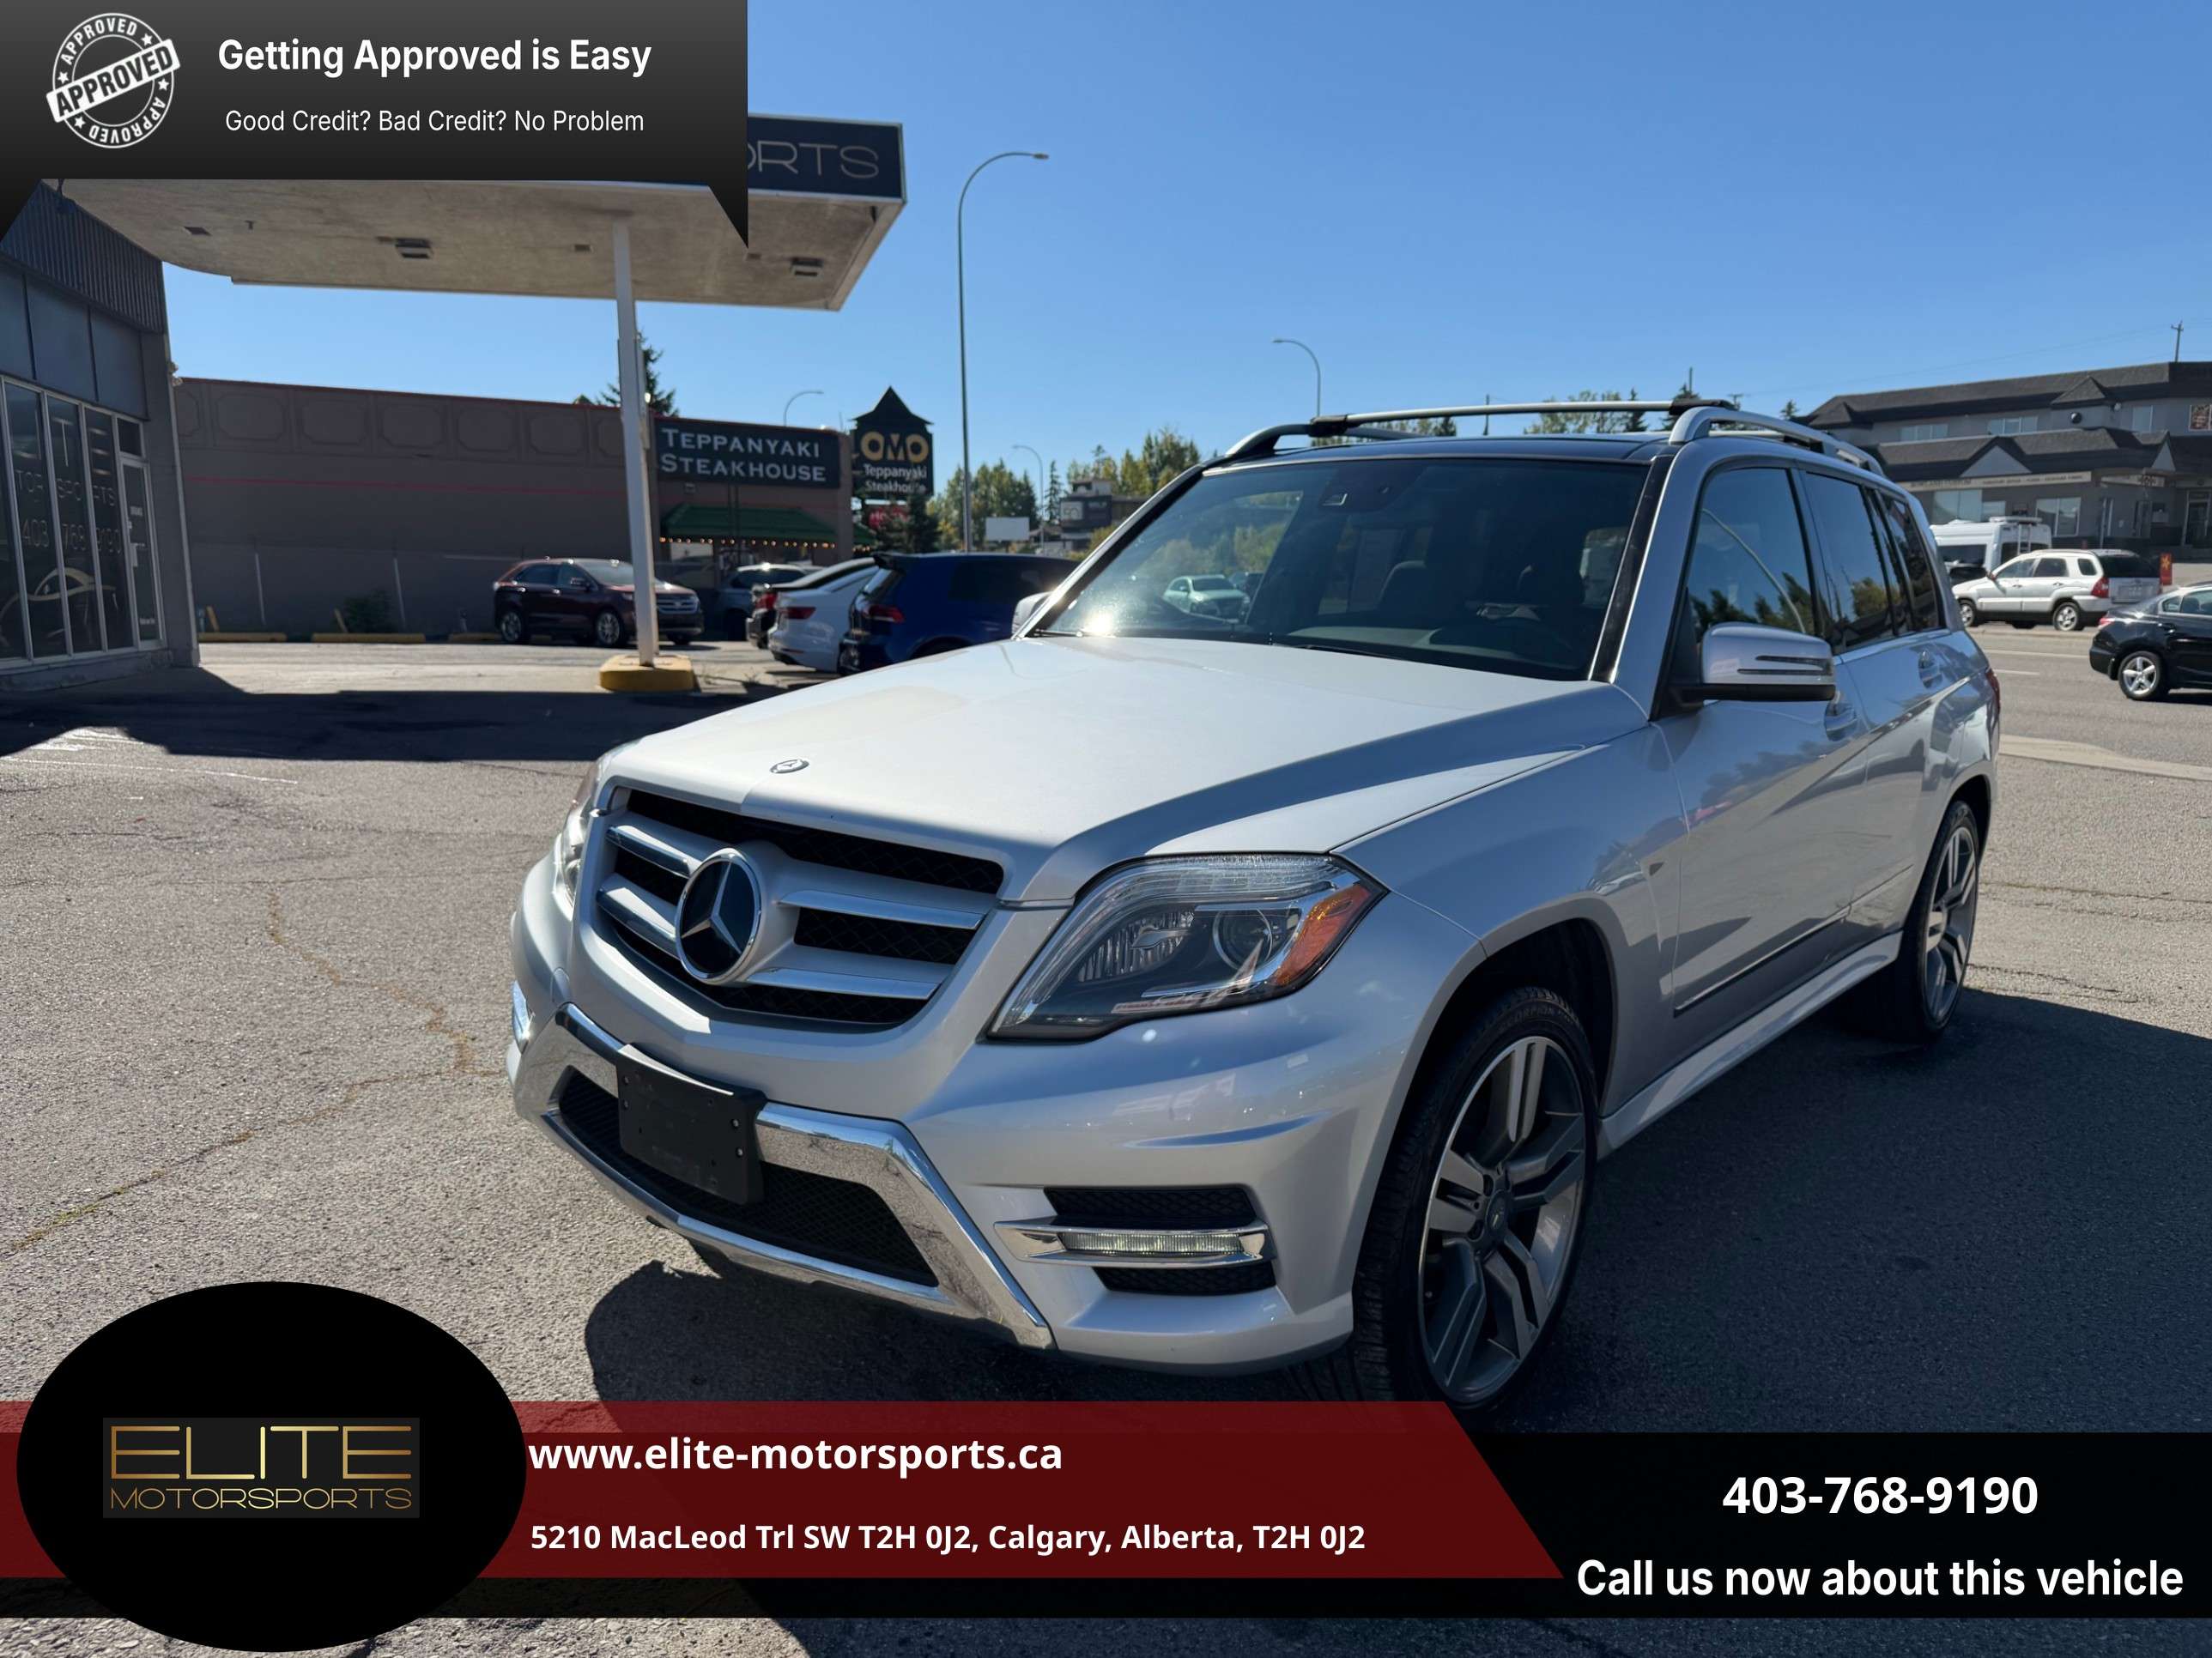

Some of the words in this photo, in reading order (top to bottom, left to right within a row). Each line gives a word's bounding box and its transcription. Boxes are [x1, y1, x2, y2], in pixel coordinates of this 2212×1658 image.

[748, 140, 880, 179] RTS
[661, 428, 821, 458] TEPPANYAKI
[860, 431, 930, 463] OMO
[661, 452, 827, 482] STEAKHOUSE
[864, 464, 927, 479] Teppanyaki
